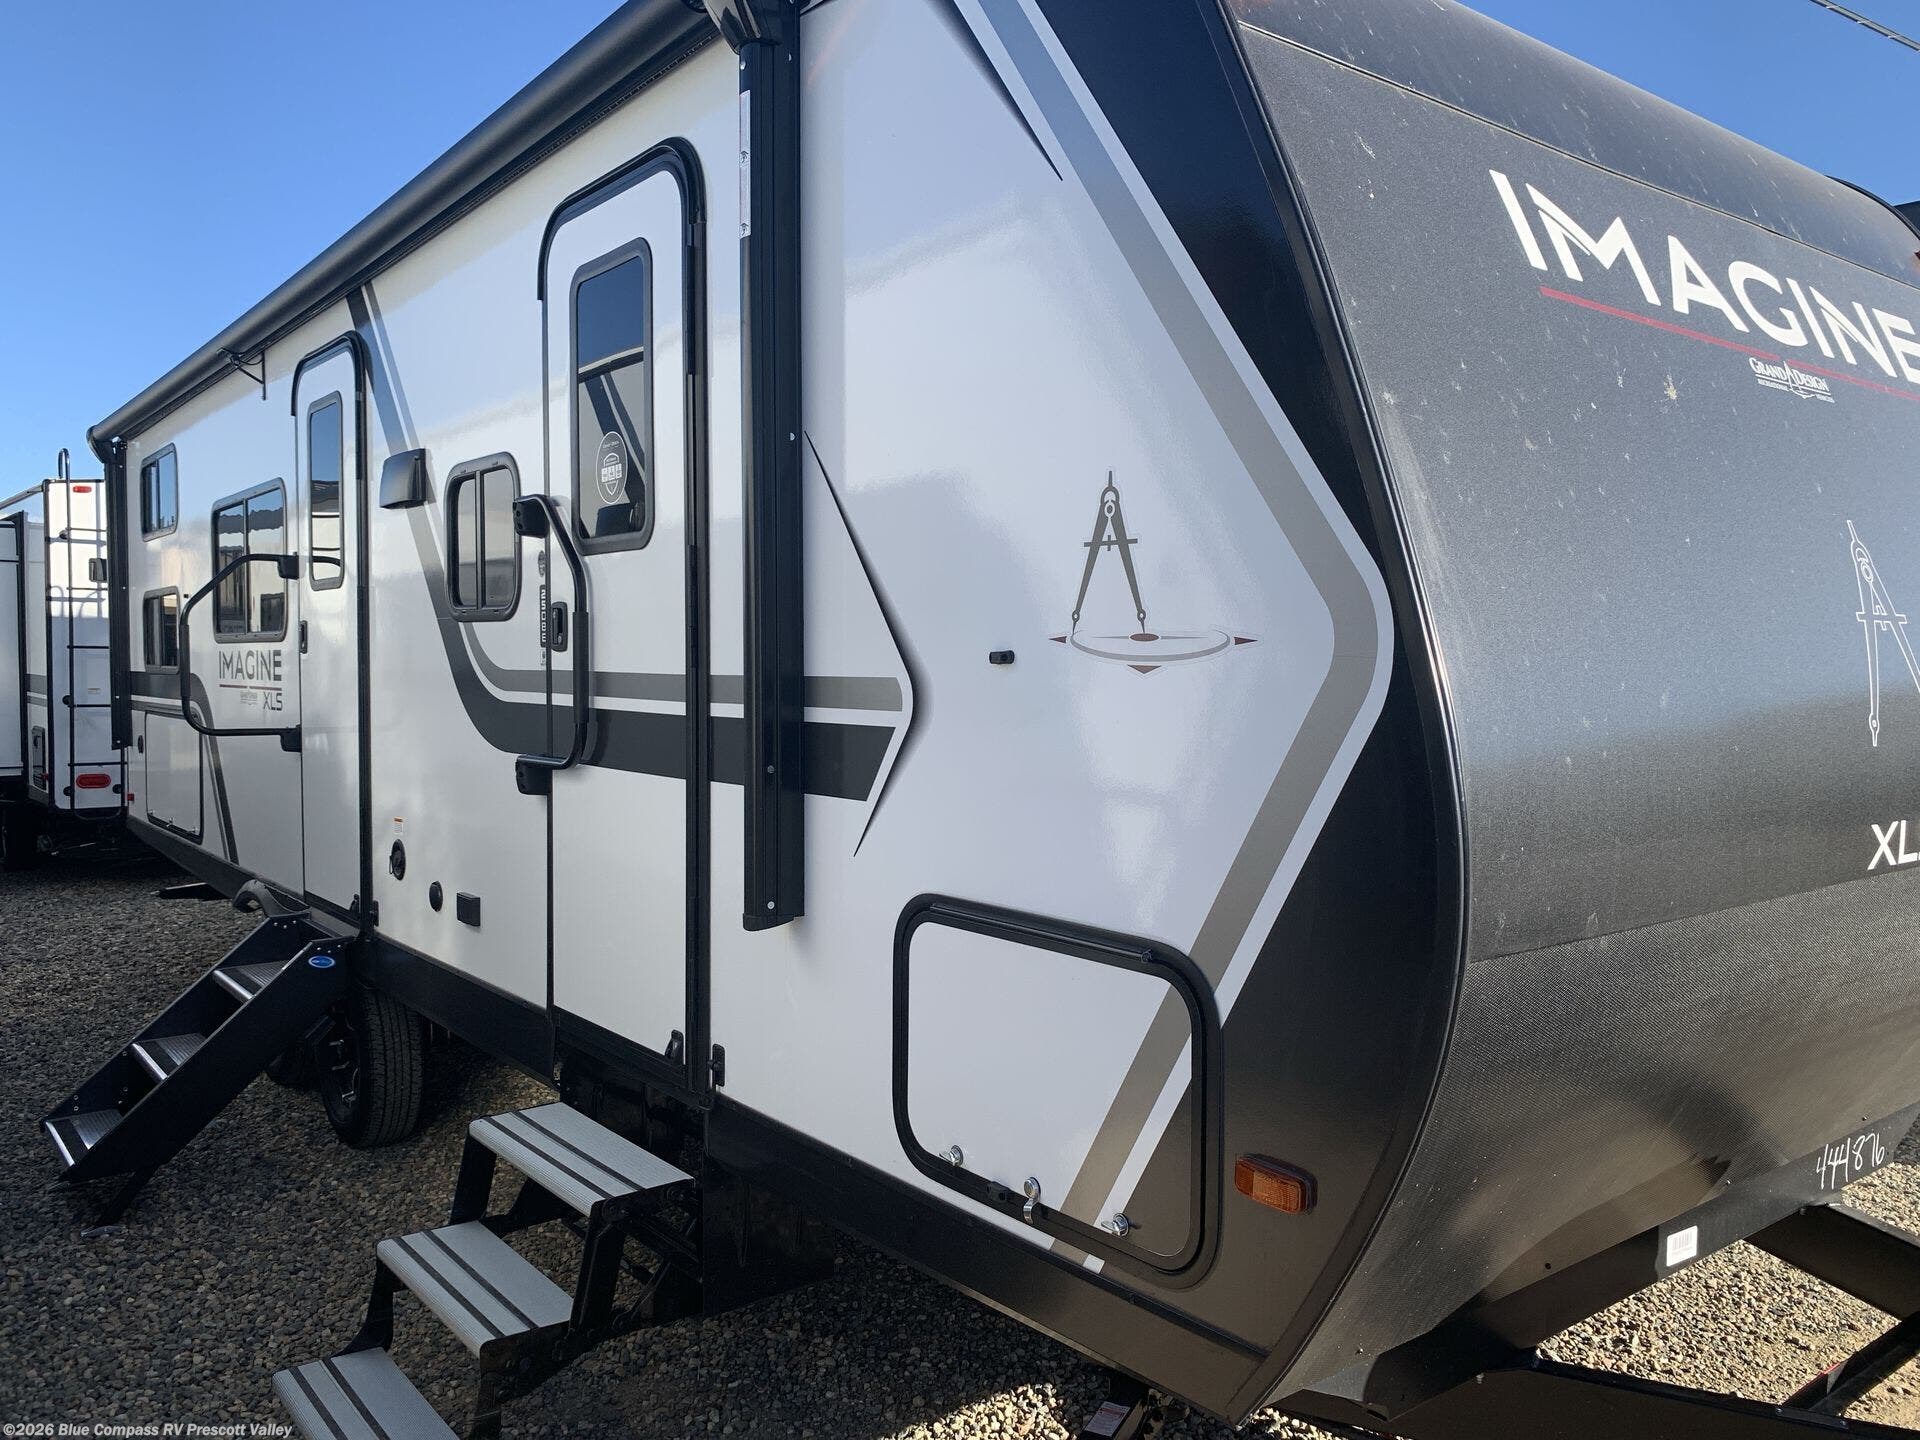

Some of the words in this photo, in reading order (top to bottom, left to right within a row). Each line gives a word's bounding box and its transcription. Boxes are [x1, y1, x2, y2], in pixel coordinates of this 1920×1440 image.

[1489, 169, 1920, 384] IMAGINE
[1749, 357, 1787, 381] GRAND
[219, 650, 282, 682] IMAGINE
[263, 692, 283, 711] XLS
[1867, 820, 1920, 871] XL
[1816, 1132, 1885, 1190] 444876
